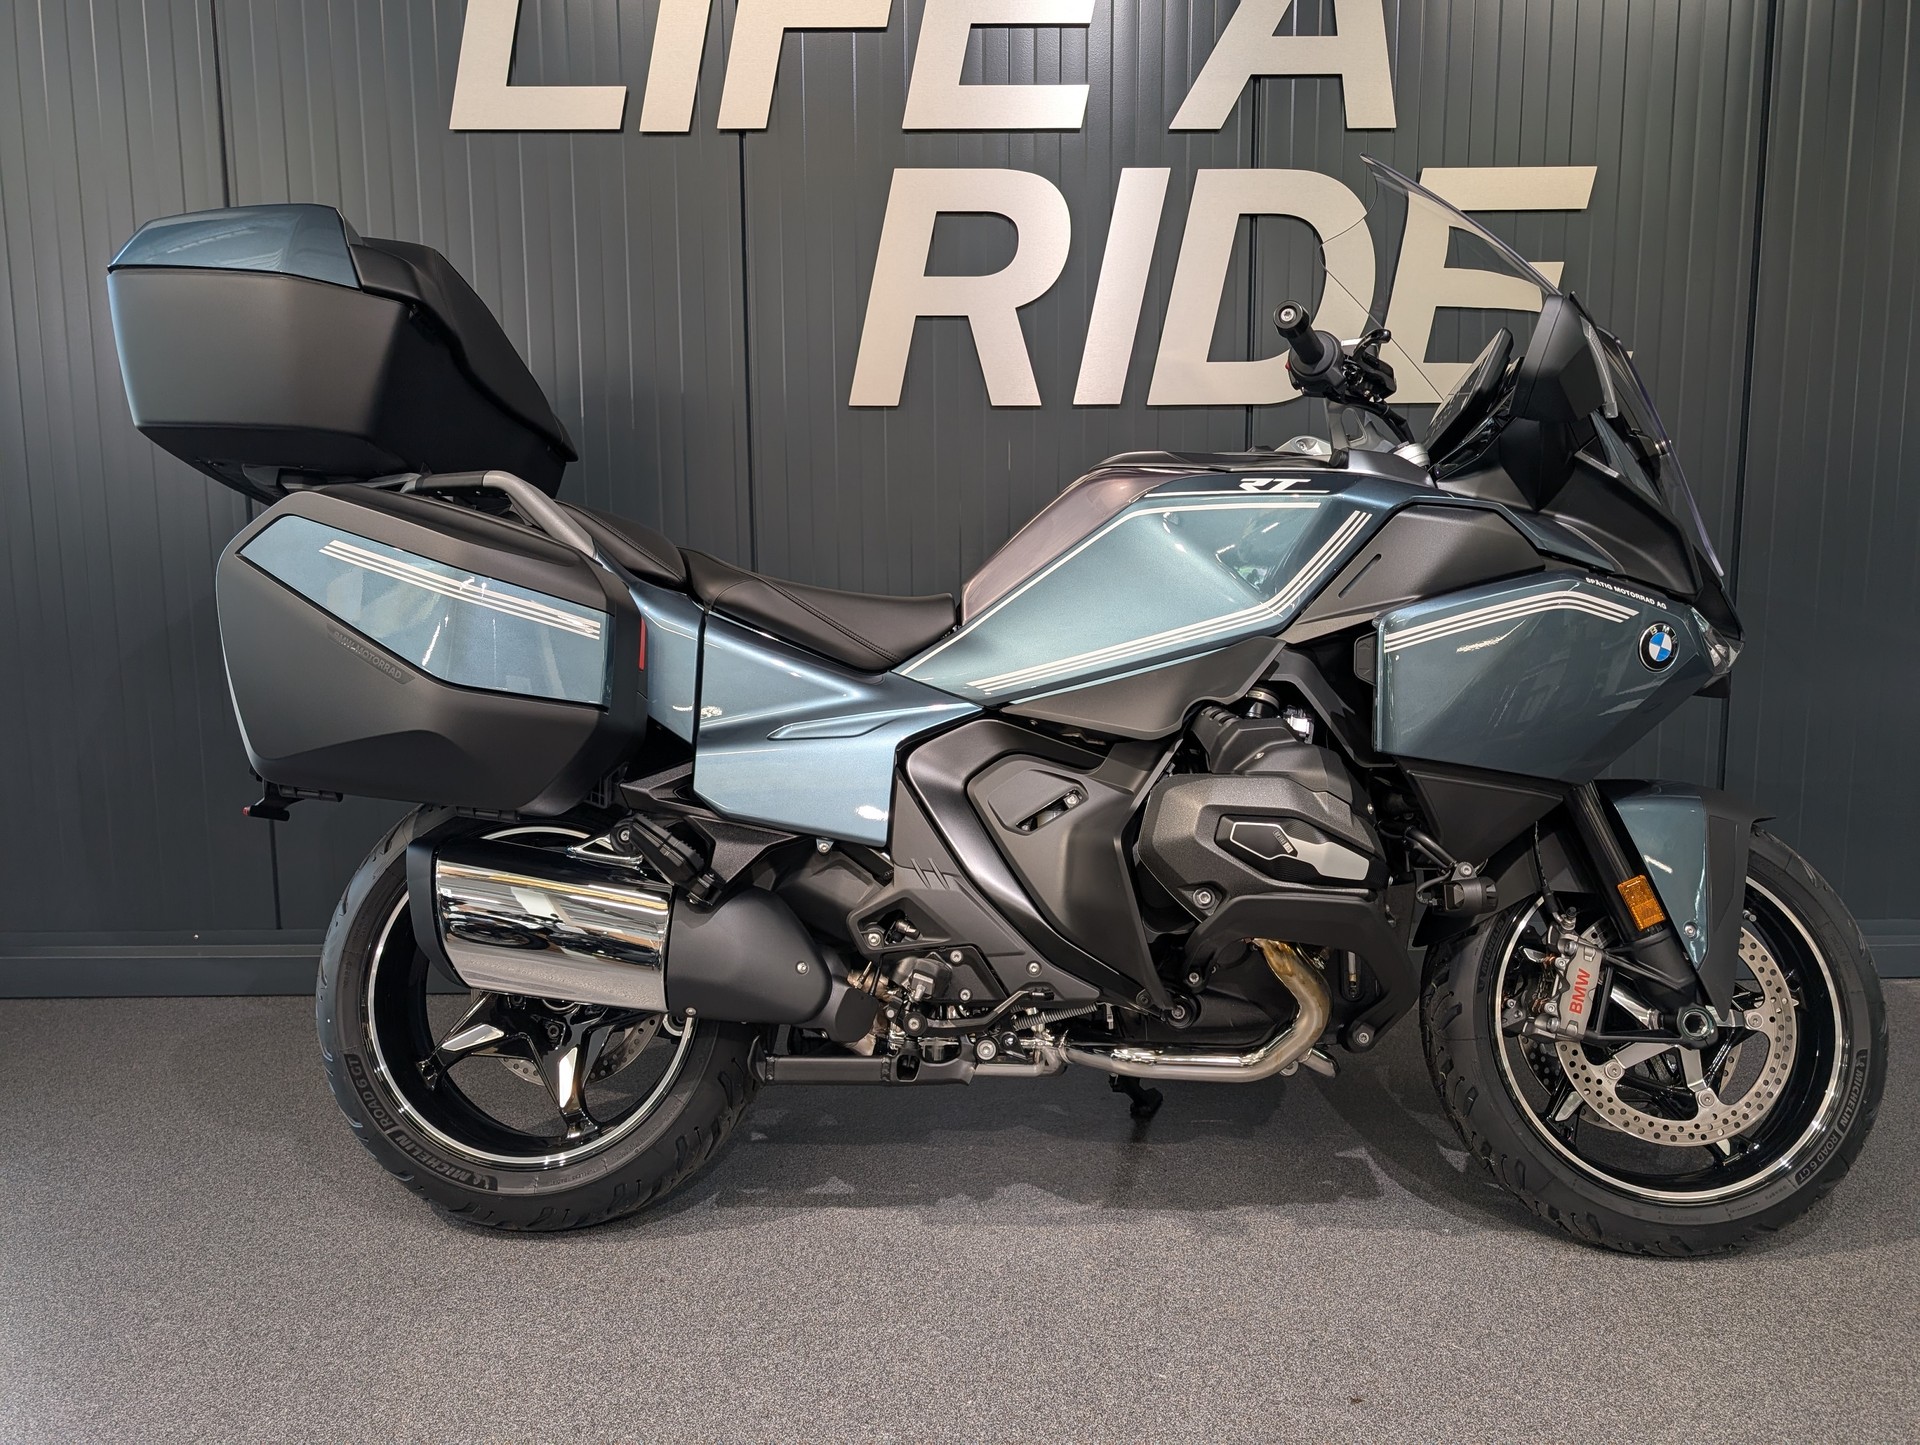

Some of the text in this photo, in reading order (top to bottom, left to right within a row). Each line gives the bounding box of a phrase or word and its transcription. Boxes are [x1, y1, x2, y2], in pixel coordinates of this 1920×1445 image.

[848, 166, 1597, 407] RIDE
[1239, 478, 1312, 492] RT
[1613, 586, 1655, 605] MOTORRAD
[354, 645, 402, 679] MOTORRAD
[1569, 968, 1591, 1014] BMW
[347, 1056, 470, 1182] MICHELIN ROAD 6 GT
[1799, 1069, 1864, 1181] MICHELIN ROAD 6 GT
